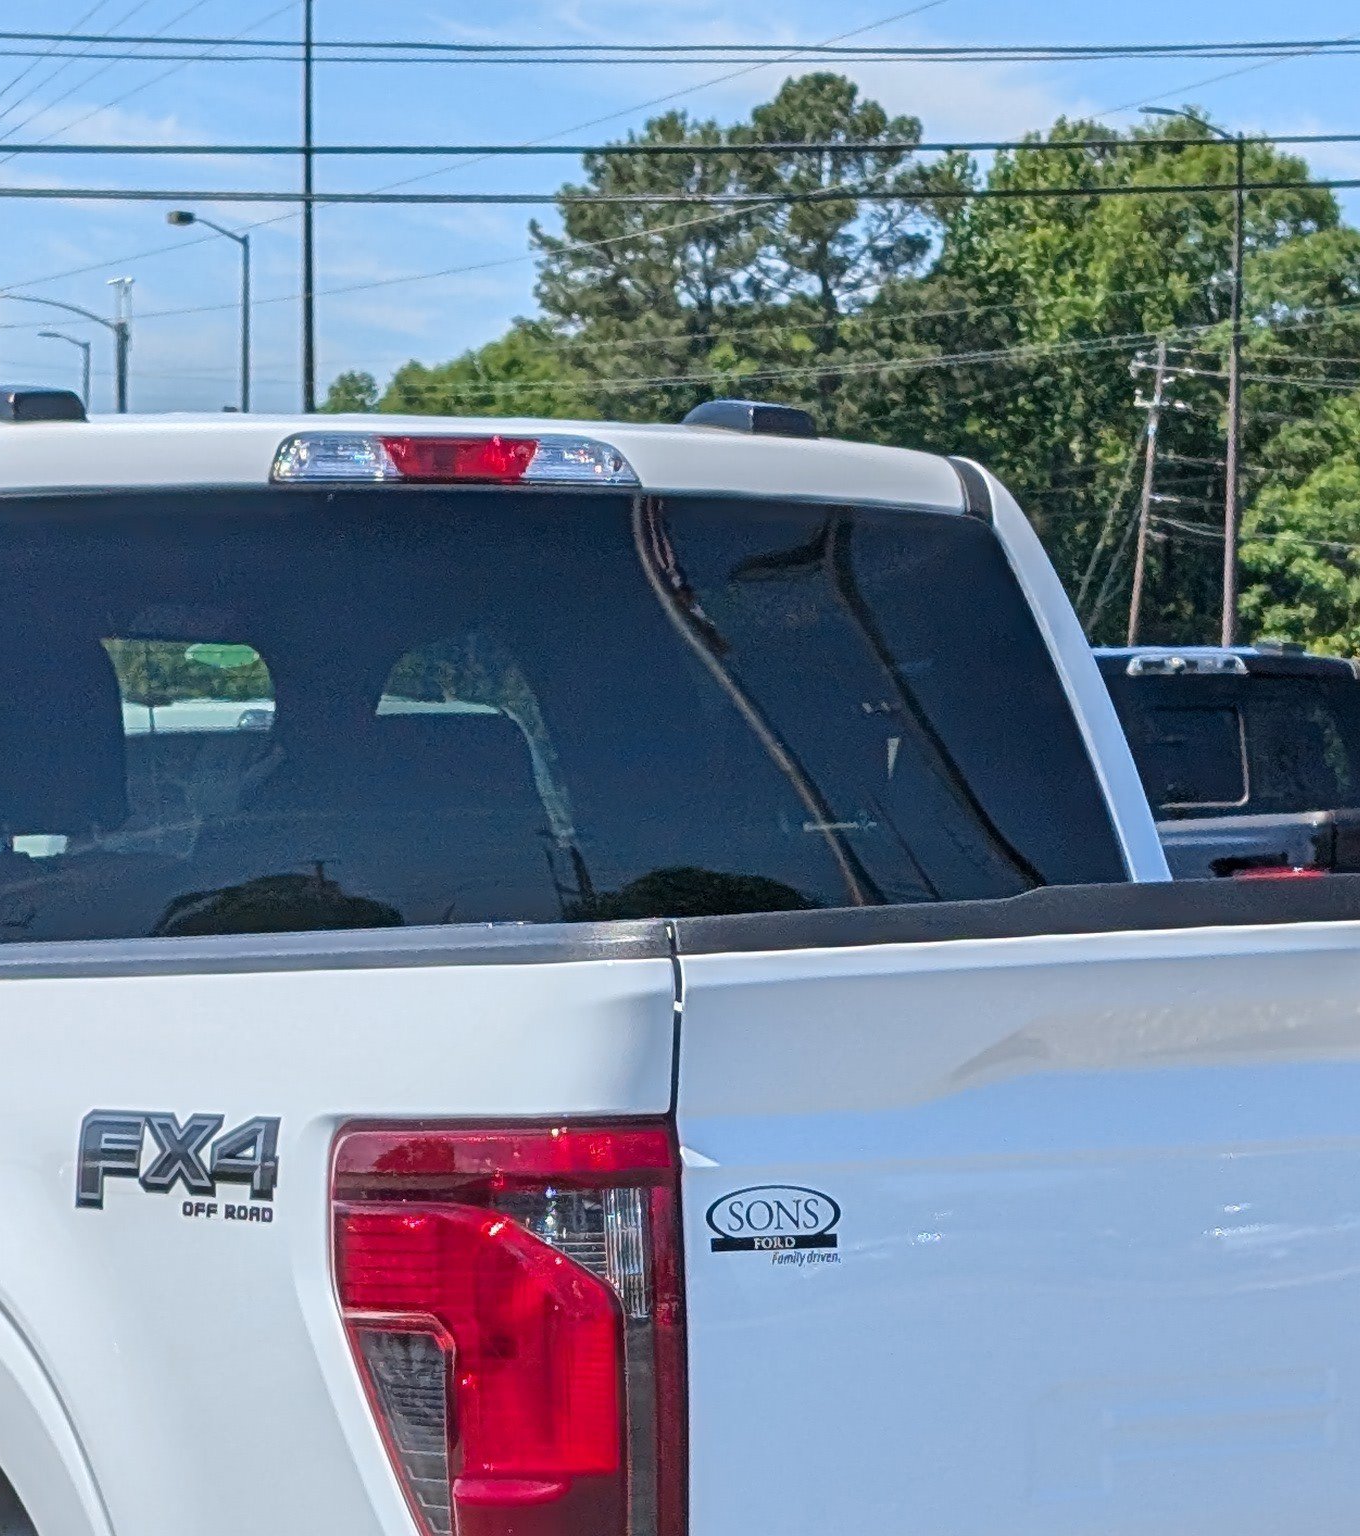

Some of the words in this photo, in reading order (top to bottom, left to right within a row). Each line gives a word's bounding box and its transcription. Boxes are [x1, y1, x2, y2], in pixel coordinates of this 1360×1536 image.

[75, 1108, 282, 1210] FX4
[182, 1201, 218, 1218] OFF
[224, 1203, 273, 1223] ROAD
[727, 1198, 819, 1232] SONS
[753, 1236, 796, 1249] FORD
[771, 1251, 805, 1267] Family
